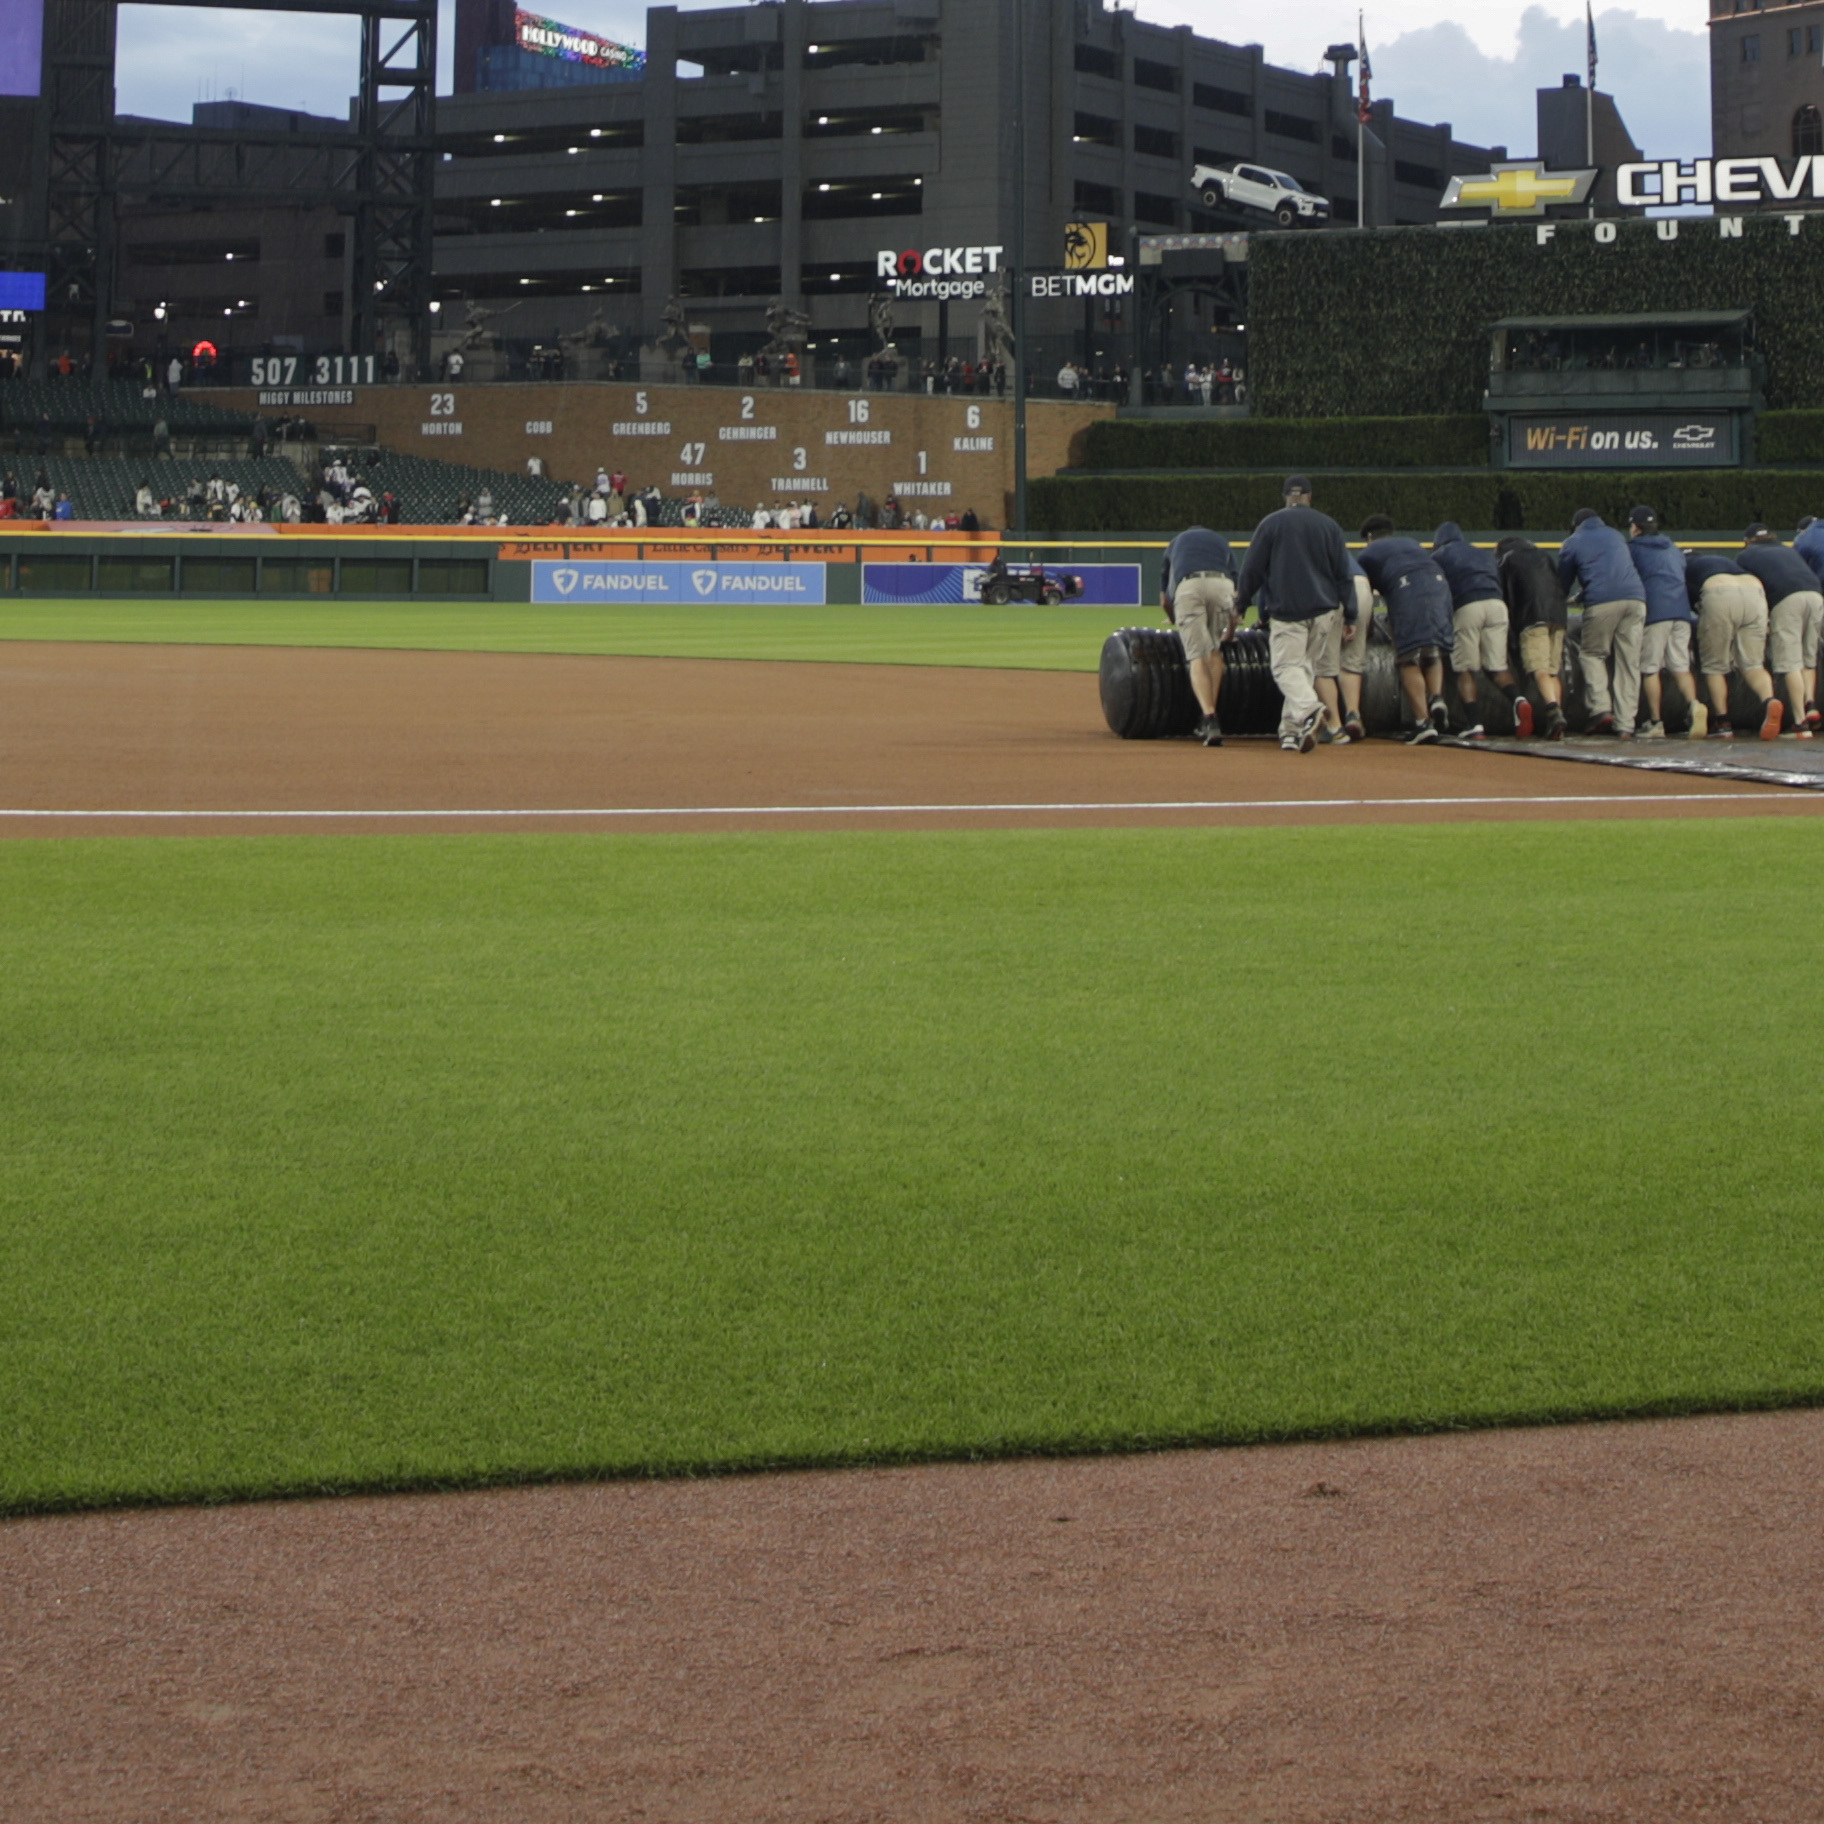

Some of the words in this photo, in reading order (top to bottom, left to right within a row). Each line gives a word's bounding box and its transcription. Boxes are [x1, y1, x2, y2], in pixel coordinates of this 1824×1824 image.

[521, 24, 599, 58] HOLLYWOOD
[877, 245, 1004, 277] ROCKET
[895, 277, 986, 301] Mortgage
[1031, 272, 1135, 297] BETMGM
[250, 356, 298, 386] 507
[315, 355, 375, 385] 3111
[429, 392, 456, 416] 23
[635, 391, 649, 415] 5
[741, 395, 755, 419] 2
[848, 399, 870, 424] 16
[422, 422, 463, 436] HORTON
[525, 420, 554, 435] COBB
[612, 422, 672, 436] GREENBERG
[966, 404, 981, 430] 6
[718, 426, 777, 441] GEHRINGER
[825, 430, 892, 445] NEWHOUSER
[953, 437, 994, 452] KALINE
[1526, 426, 1589, 451] Wi-Fi
[1590, 430, 1620, 450] on
[1624, 429, 1659, 450] us.
[679, 442, 707, 466] 47
[792, 446, 807, 471] 3
[917, 450, 927, 475] 1
[671, 473, 713, 487] MORRIS
[771, 477, 829, 492] TRAMMELL
[893, 481, 953, 497] WHITAKER
[582, 574, 670, 591] FANDUEL
[721, 575, 807, 592] FANDUEL
